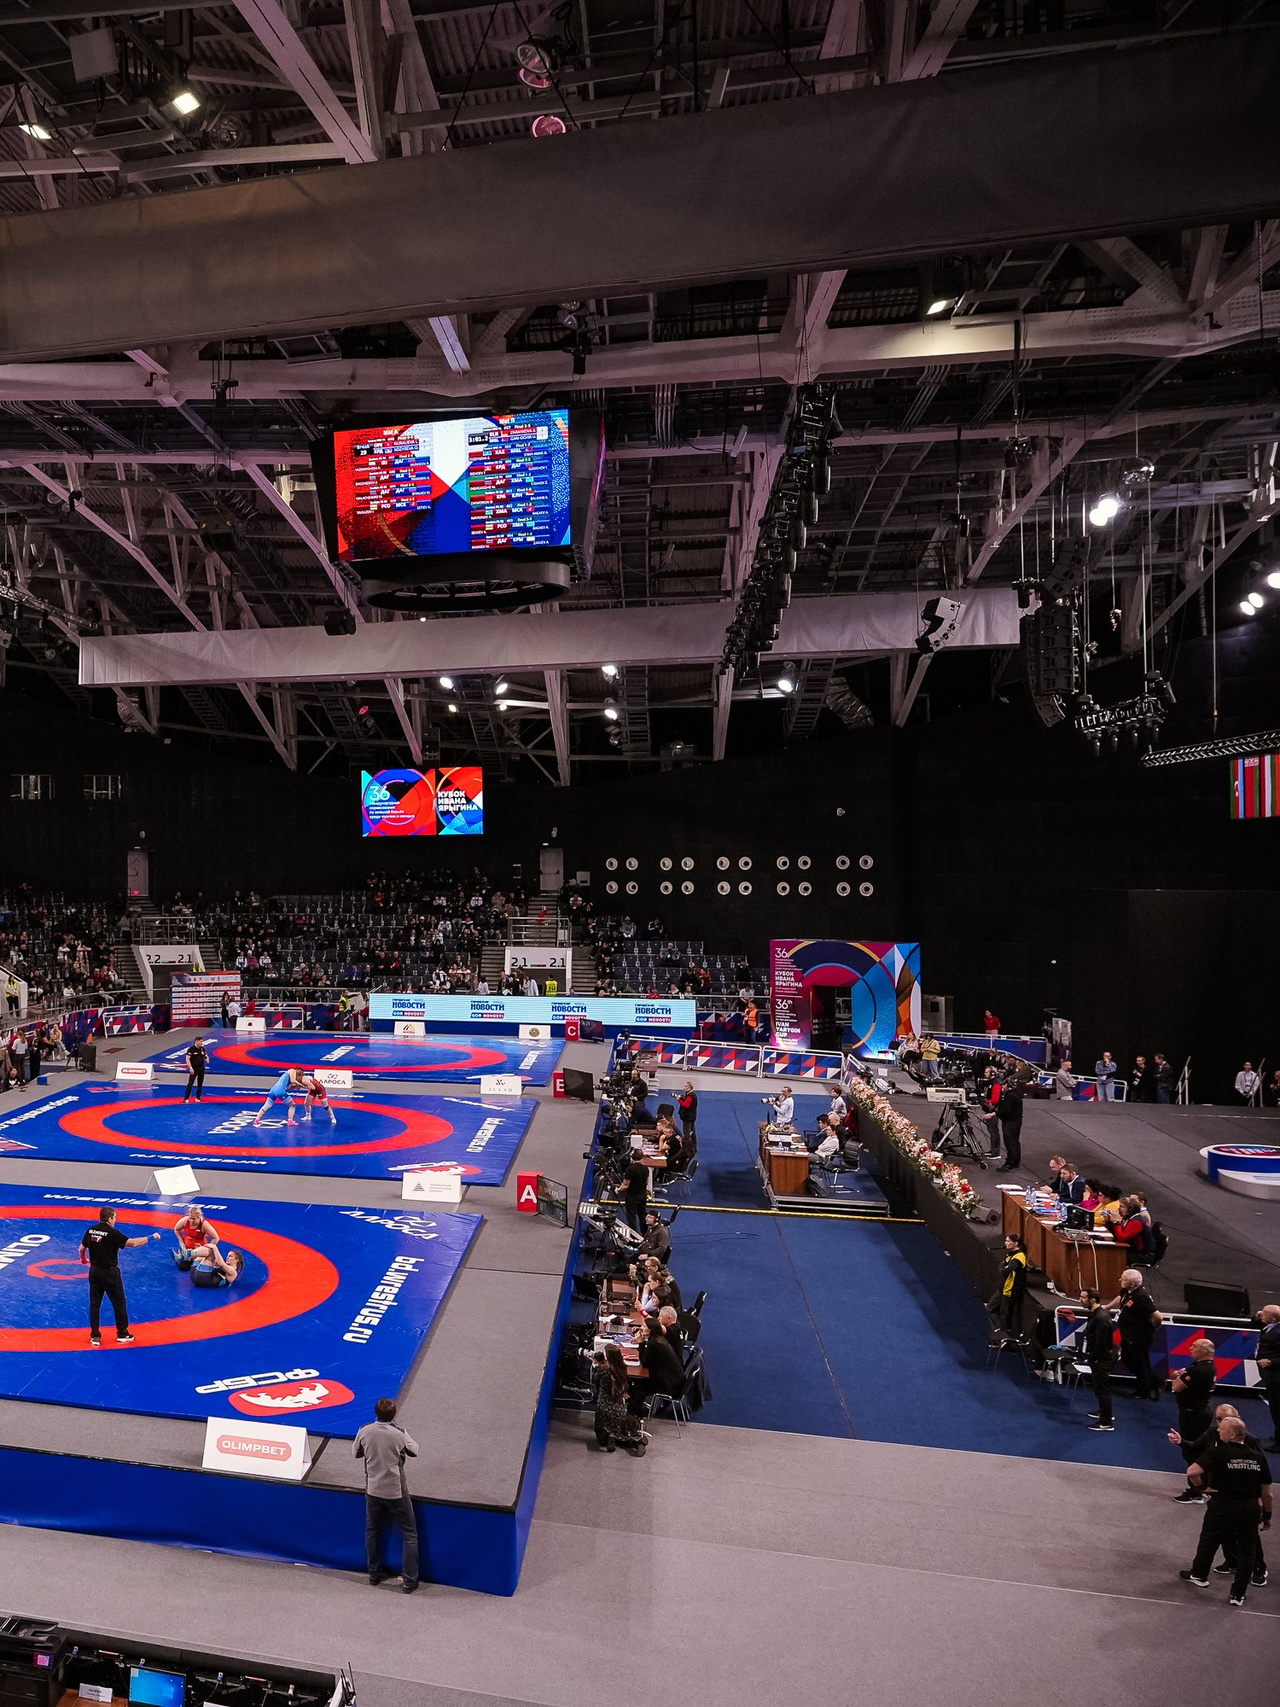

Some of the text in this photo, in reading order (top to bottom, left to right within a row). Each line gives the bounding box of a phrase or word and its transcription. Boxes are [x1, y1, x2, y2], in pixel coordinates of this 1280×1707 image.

[370, 785, 390, 801] 36
[438, 790, 466, 799] КУБОК
[438, 804, 478, 812] ЯРЫГИНА
[775, 947, 789, 959] 36
[178, 954, 193, 964] 2.1
[549, 958, 567, 968] 2.1
[470, 1003, 505, 1011] НОВОСТИ
[552, 1005, 587, 1013] НОВОСТИ
[635, 1007, 672, 1015] НОВОСТИ
[568, 1025, 577, 1037] C
[520, 1184, 537, 1204] A
[343, 1255, 425, 1344] bd.wrestrus.ru
[195, 1368, 320, 1394] ФСБР
[221, 1440, 287, 1456] OLIMPBET
[1227, 1463, 1261, 1471] WRESTLING
